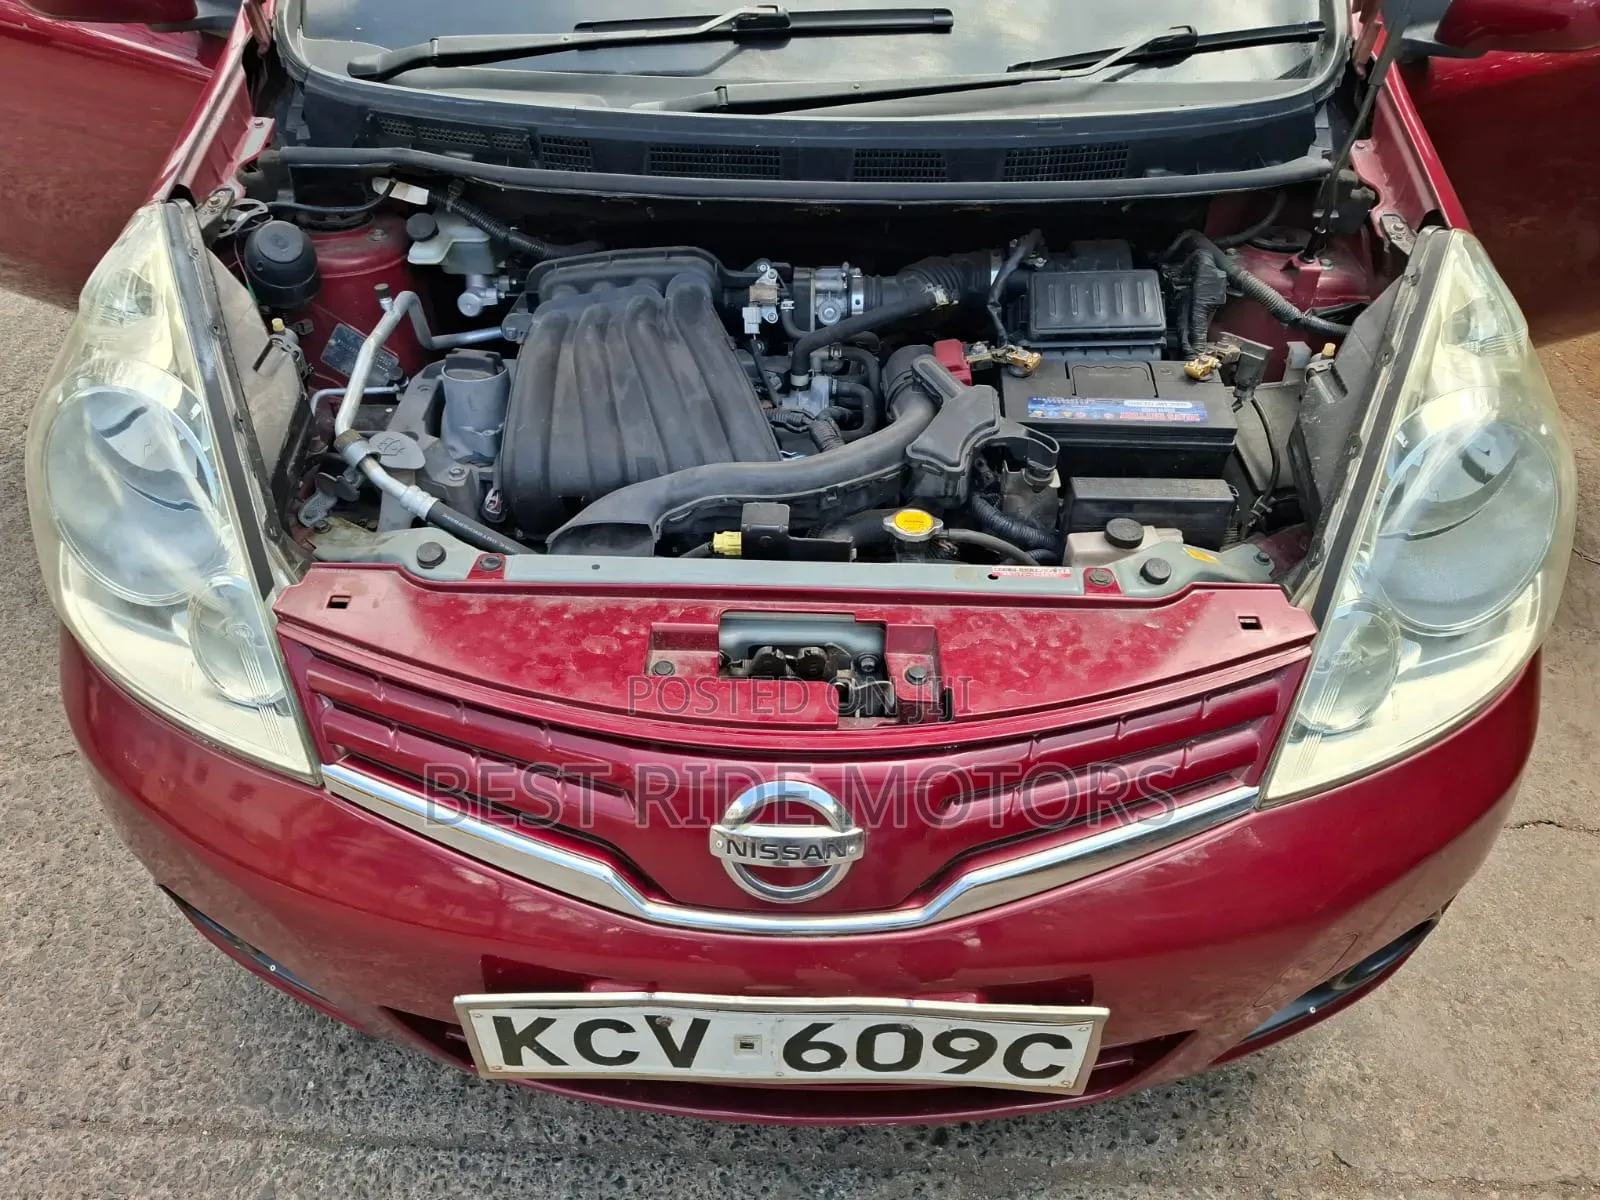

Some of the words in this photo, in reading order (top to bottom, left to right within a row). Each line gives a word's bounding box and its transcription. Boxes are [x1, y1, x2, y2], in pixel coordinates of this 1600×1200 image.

[726, 839, 847, 861] NISSAN
[492, 1014, 712, 1069] KCV
[782, 1022, 1073, 1080] 609C
